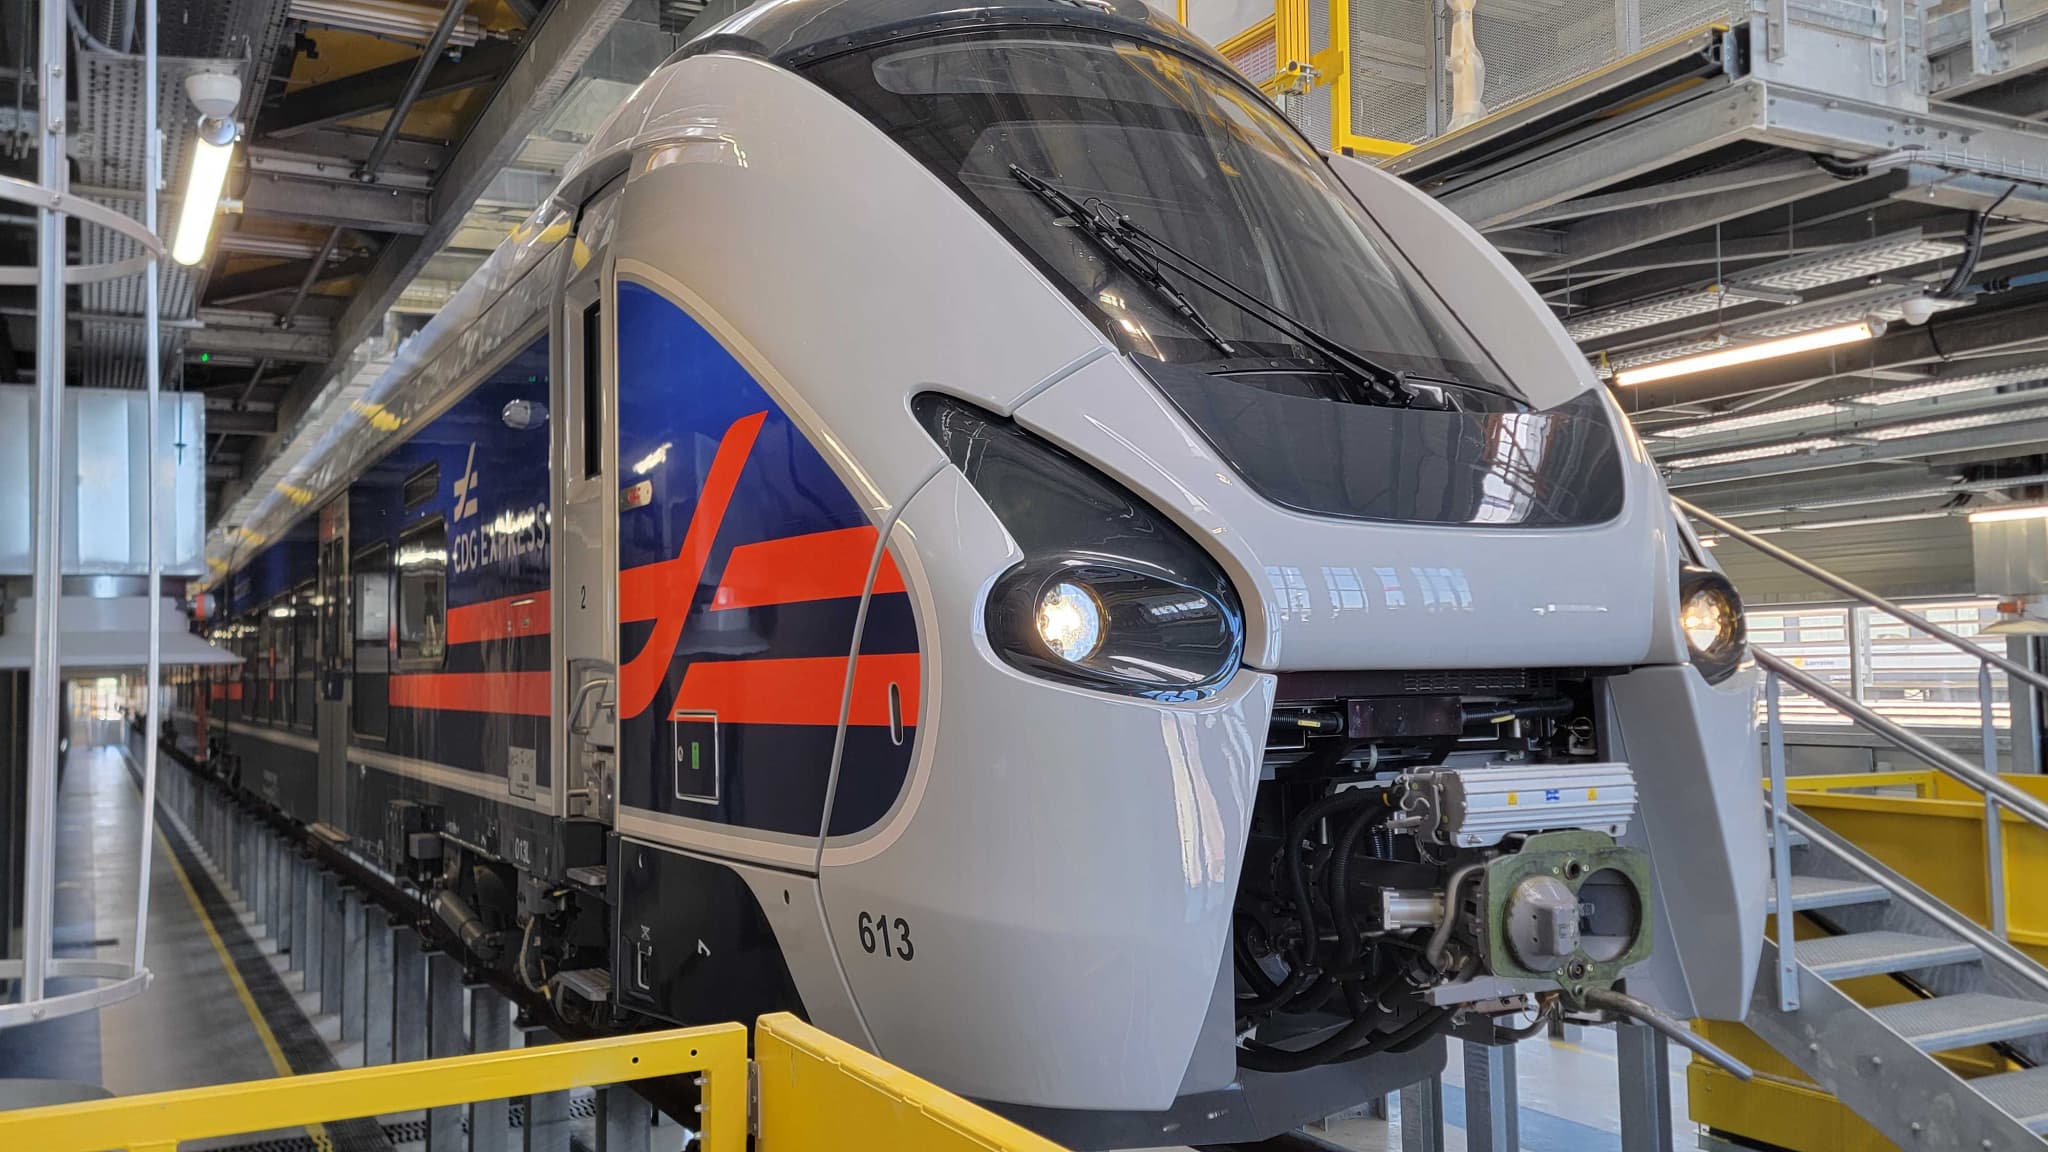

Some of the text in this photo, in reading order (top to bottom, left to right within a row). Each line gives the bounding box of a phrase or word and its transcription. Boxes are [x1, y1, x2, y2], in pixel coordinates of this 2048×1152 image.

[454, 502, 545, 574] CDG EXPRESS
[581, 584, 586, 609] 2
[858, 911, 914, 961] 613
